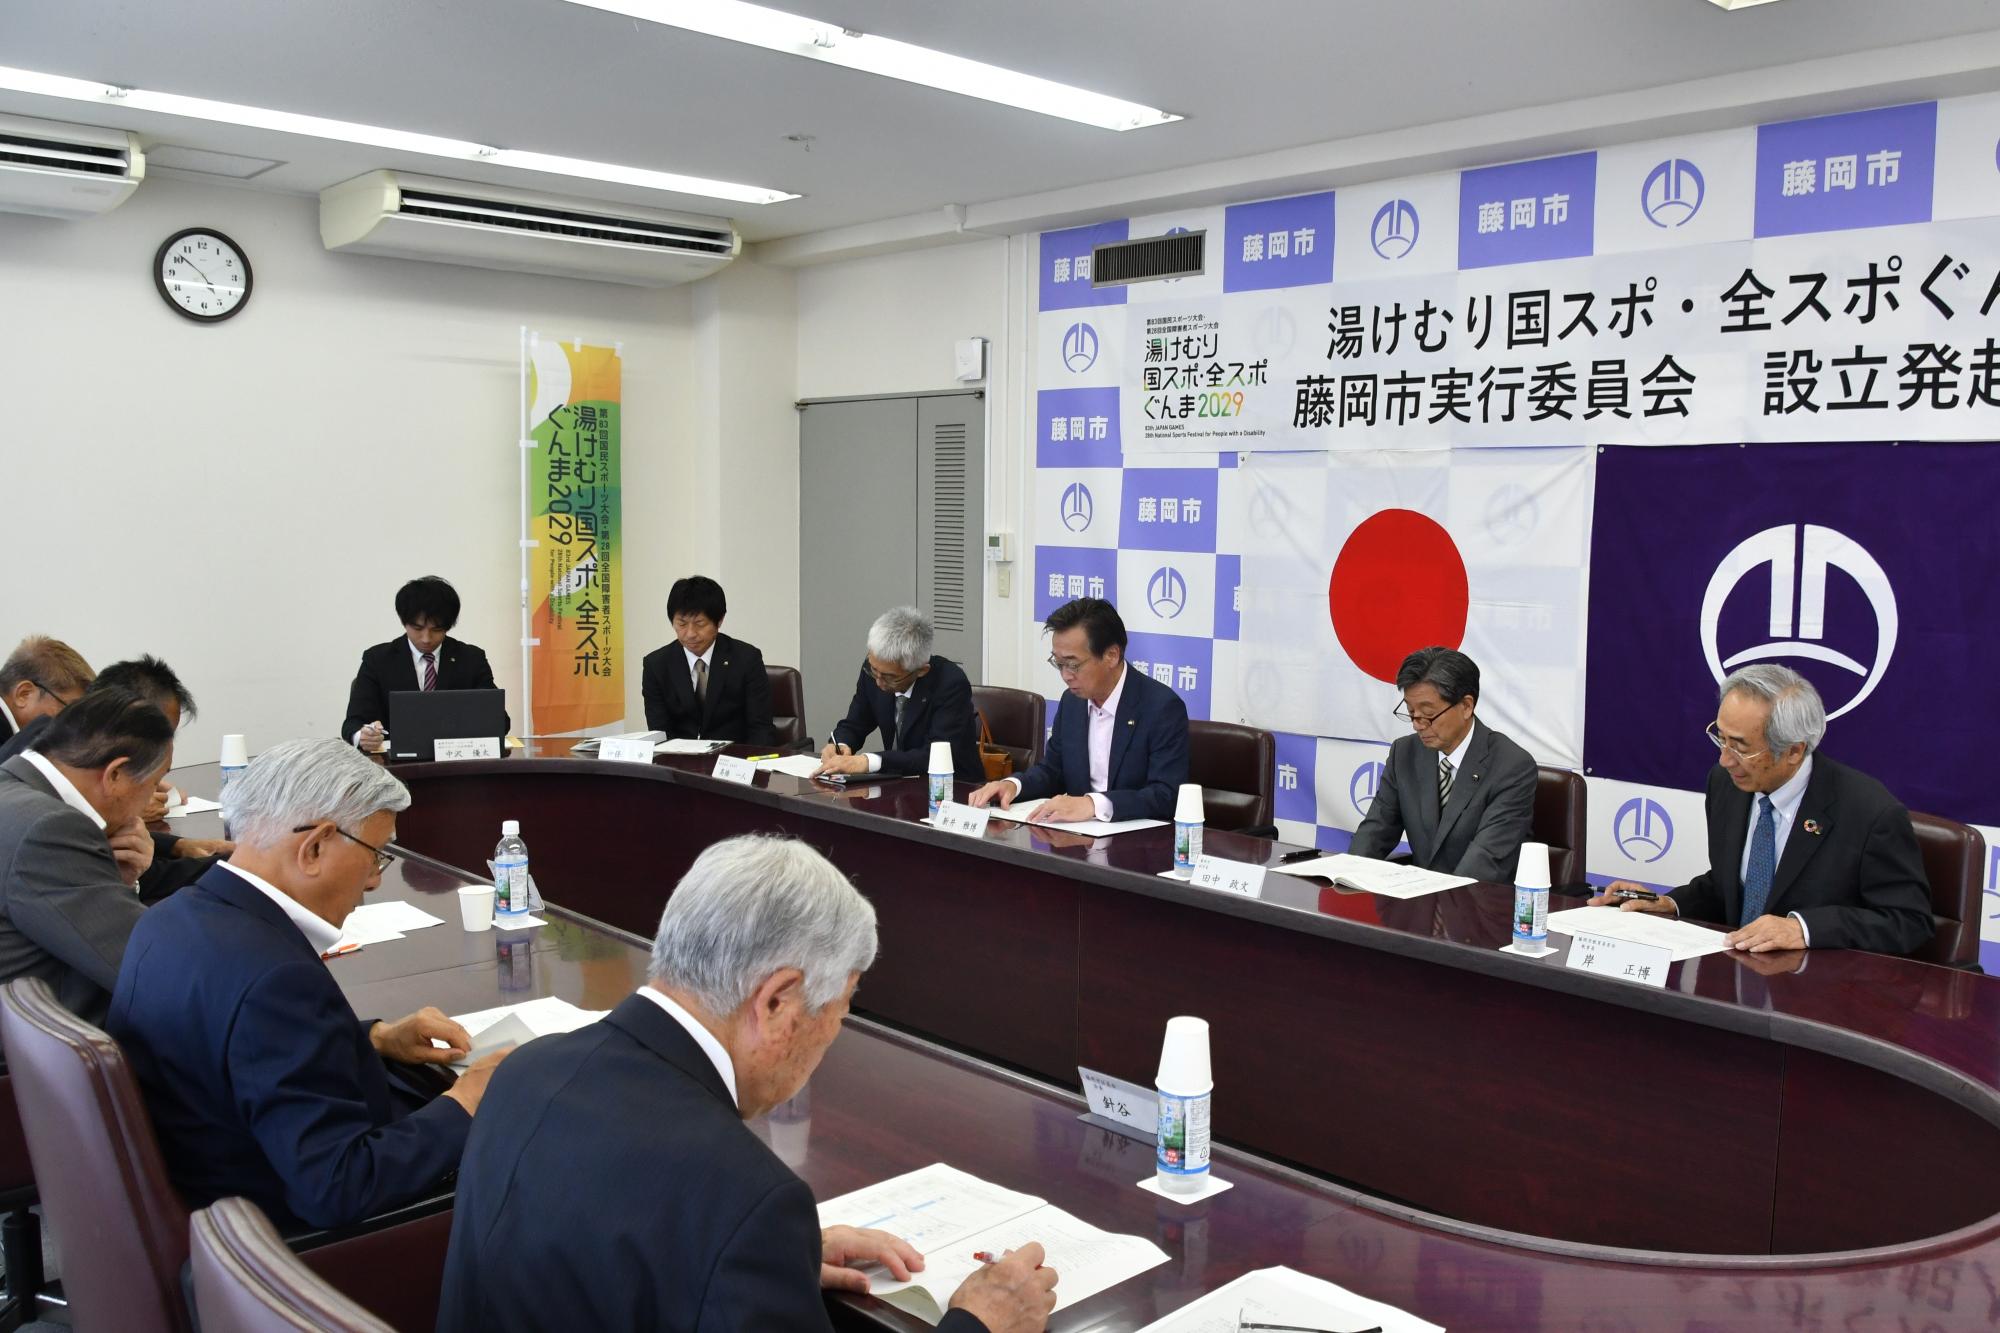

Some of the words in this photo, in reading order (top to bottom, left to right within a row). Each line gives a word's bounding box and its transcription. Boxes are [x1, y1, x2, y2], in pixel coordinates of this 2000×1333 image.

[1781, 149, 1902, 198] 藤岡市
[1477, 192, 1570, 234] 藤岡市
[1242, 227, 1316, 263] 藤岡市
[1144, 333, 1218, 362] 湯けむり
[1143, 359, 1268, 391] 国スポ・全スポ
[1144, 391, 1244, 419] ぐんま2029
[1293, 353, 1697, 428] 藤岡市実行委員会
[1050, 415, 1108, 441] 藤岡市
[548, 404, 572, 546] ぐんま2029
[1137, 497, 1202, 524] 藤岡市
[573, 405, 599, 677] 湯けむり国スポ・全スポ
[1048, 573, 1104, 600] 藤岡市
[1202, 874, 1220, 885] 田中
[1583, 953, 1595, 967] 岸
[1623, 964, 1651, 980] 正博
